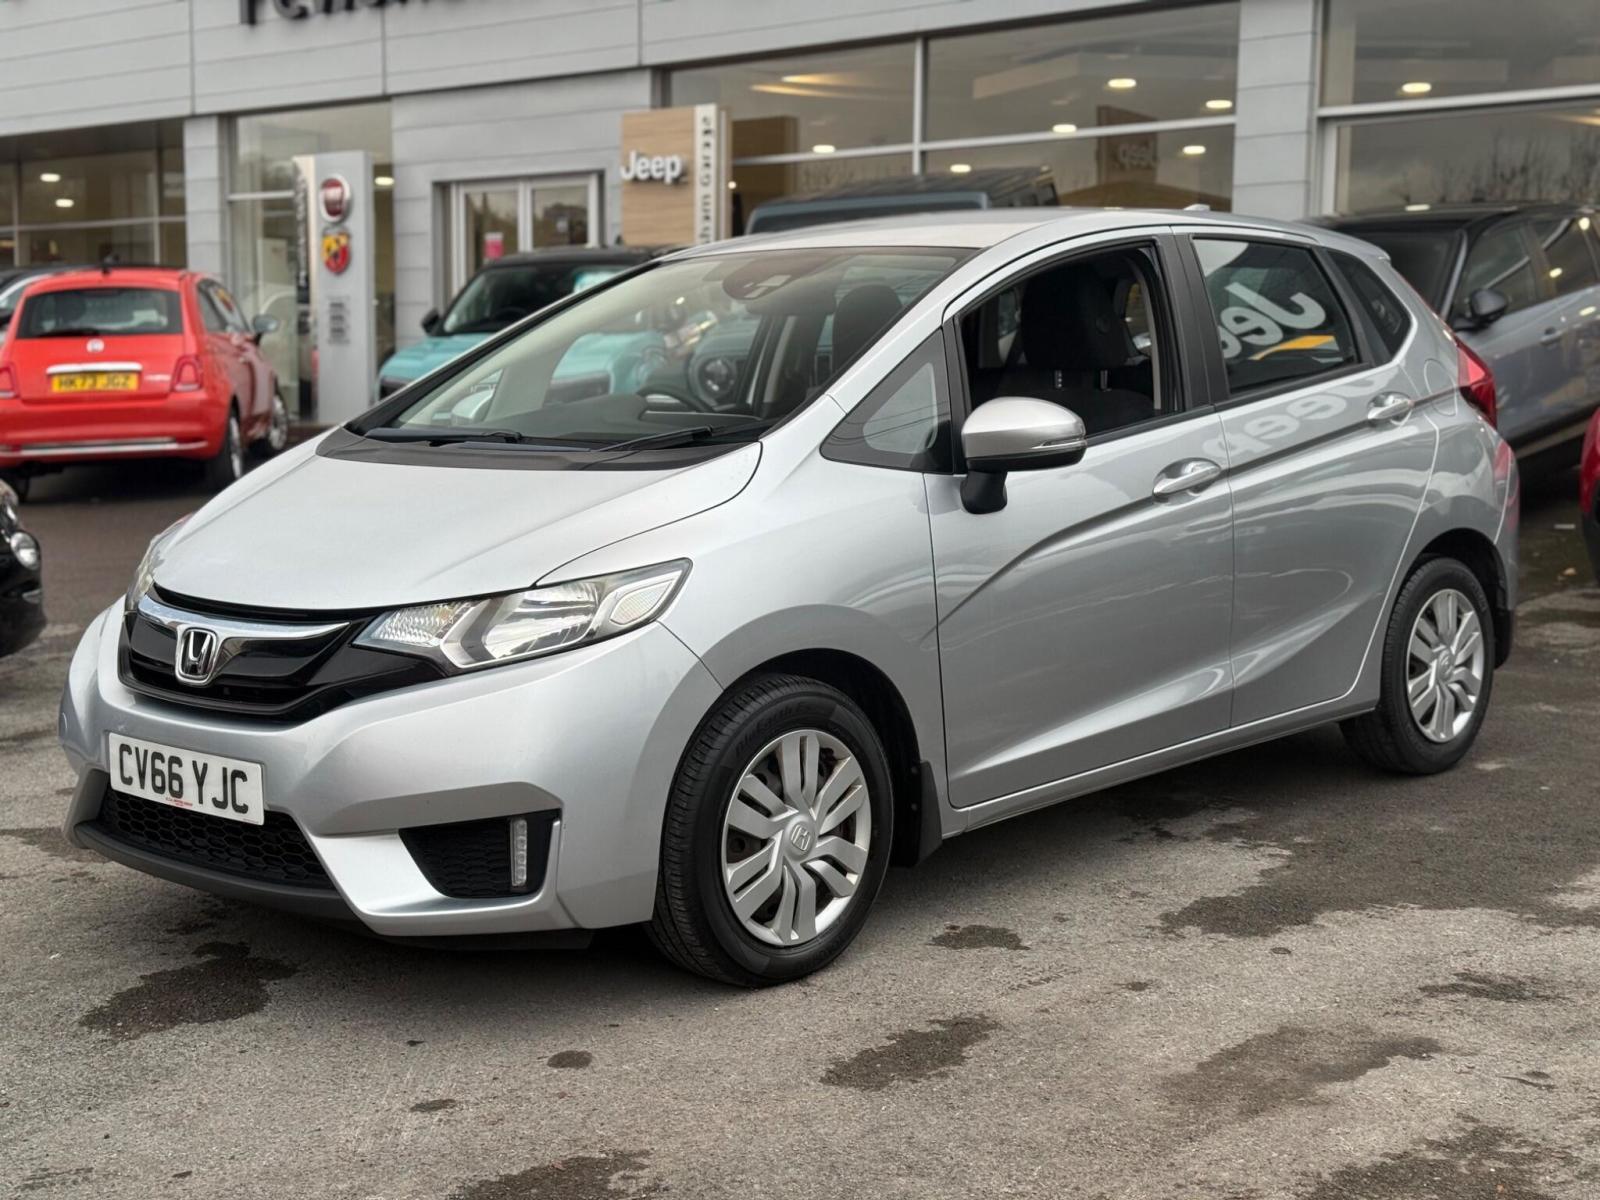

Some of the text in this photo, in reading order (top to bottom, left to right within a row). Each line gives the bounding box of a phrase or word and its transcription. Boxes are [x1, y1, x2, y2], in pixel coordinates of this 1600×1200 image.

[620, 150, 681, 184] Jeep
[119, 743, 249, 814] CV66 YJC
